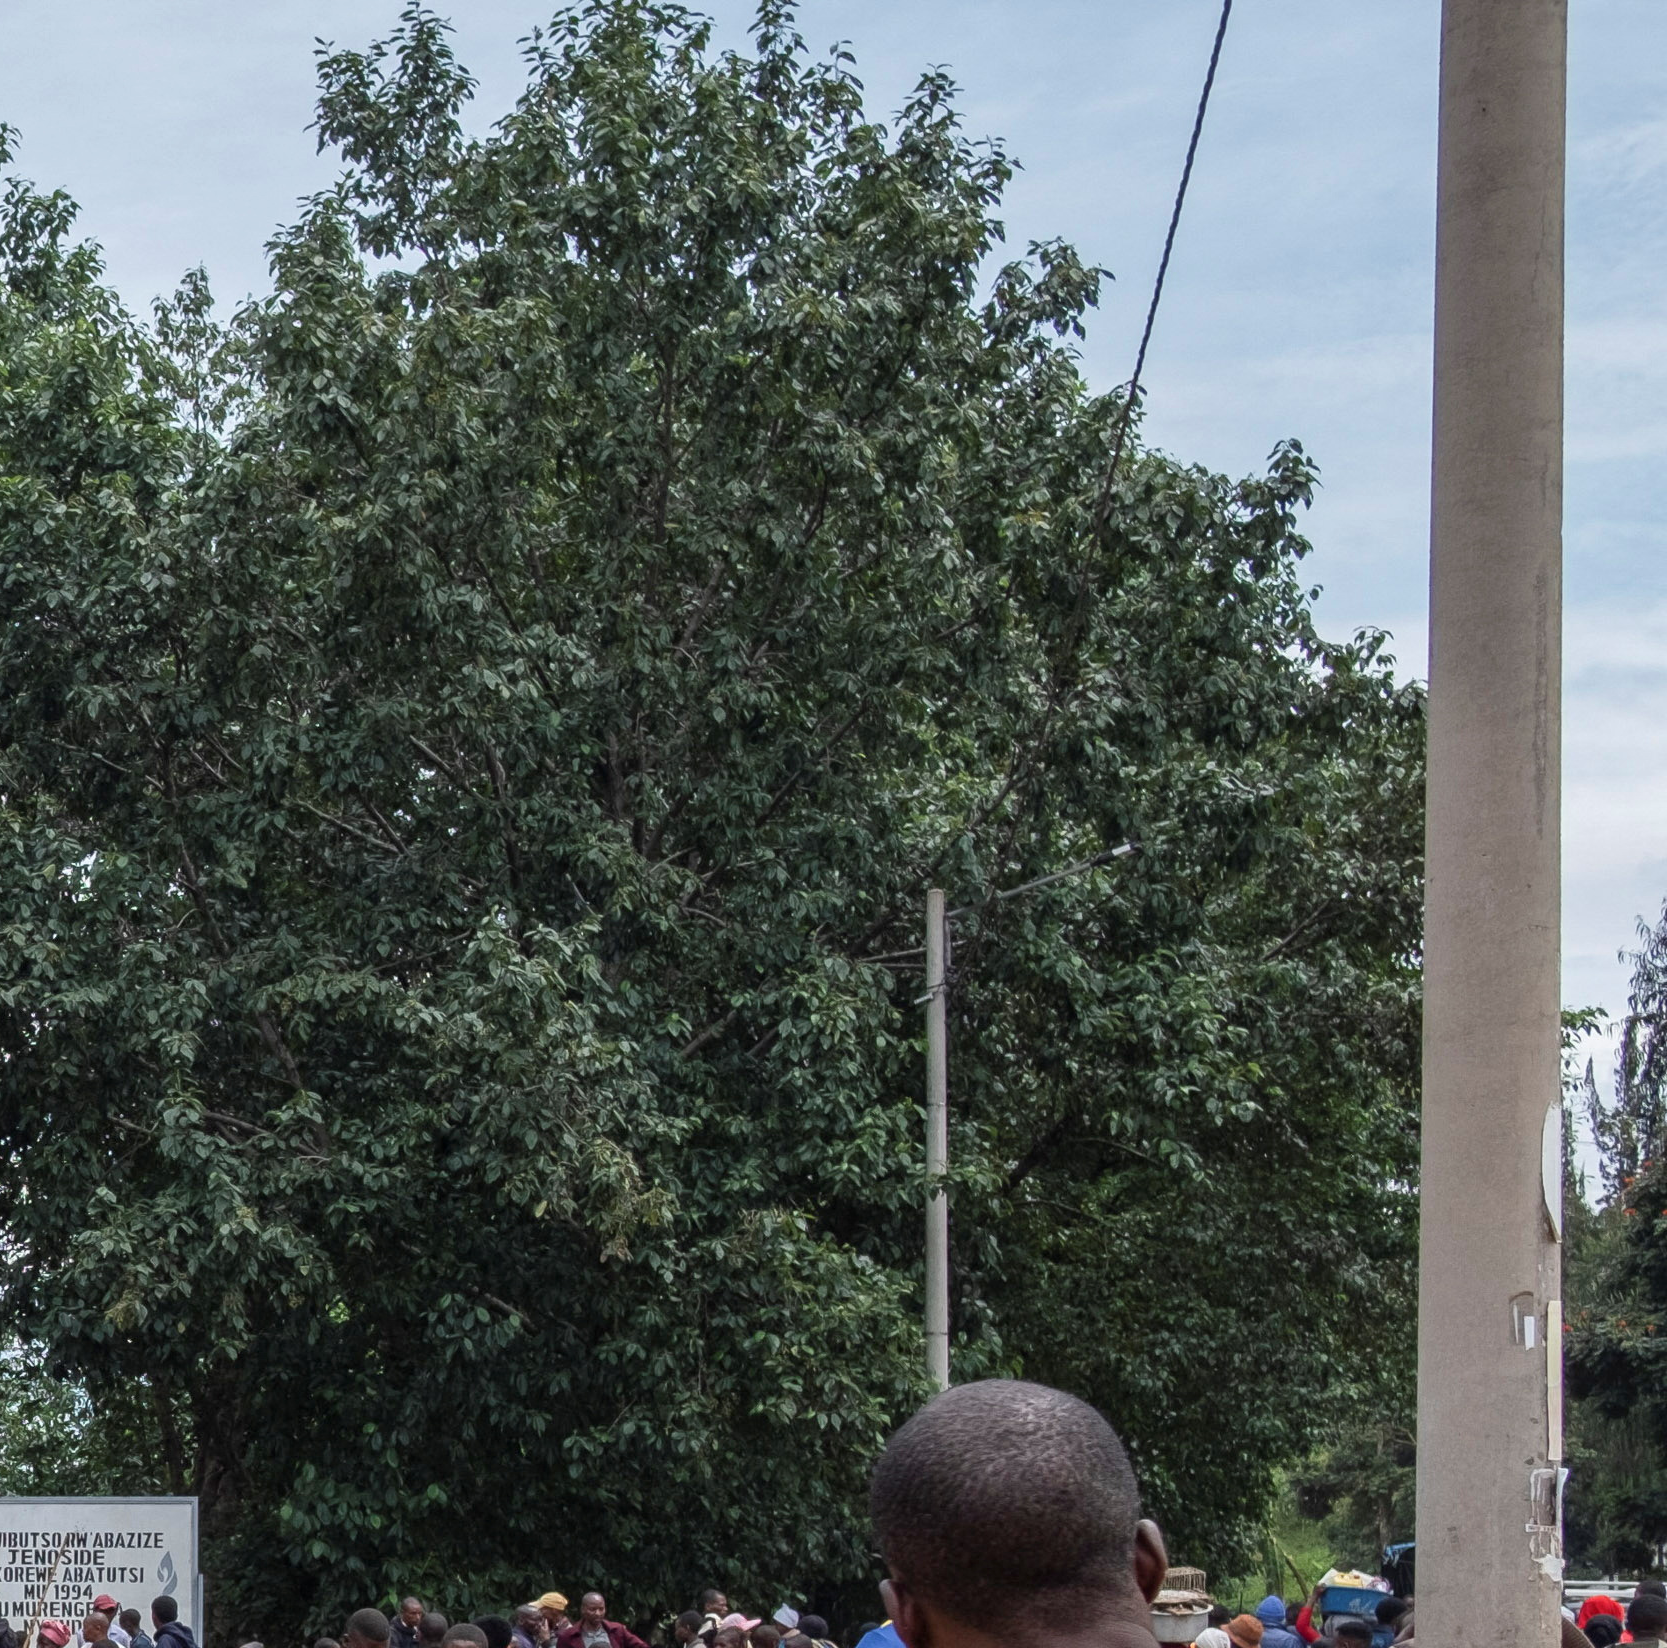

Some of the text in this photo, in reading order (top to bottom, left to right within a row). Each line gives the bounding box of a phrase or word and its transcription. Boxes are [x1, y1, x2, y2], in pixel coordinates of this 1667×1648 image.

[8, 1549, 105, 1566] JENOSIDE
[62, 1566, 145, 1583] ABATUTSI
[23, 1583, 93, 1600] MU 1994
